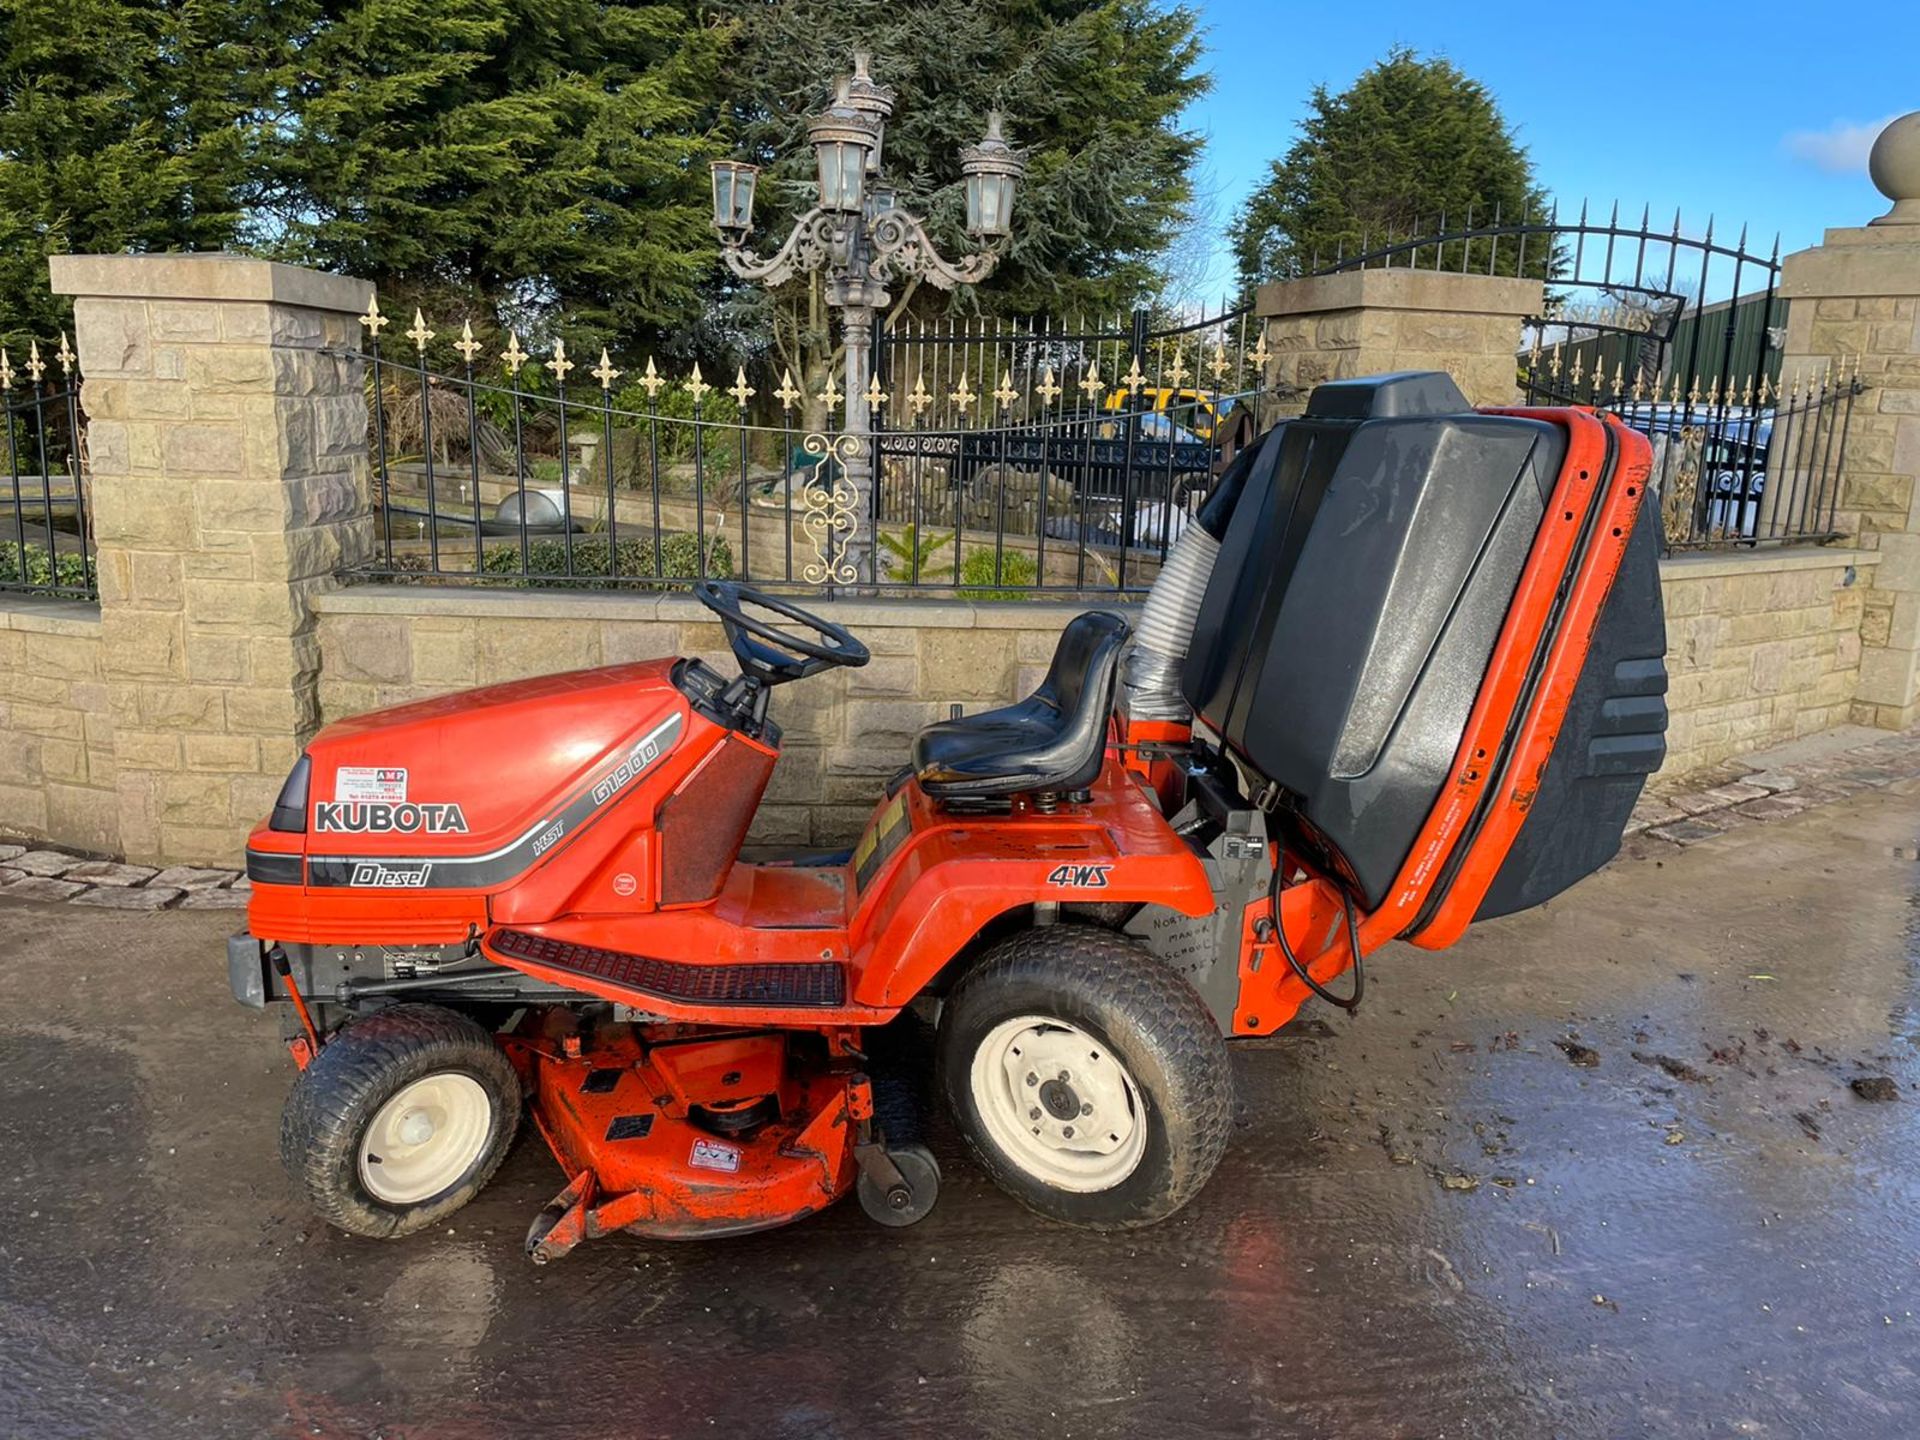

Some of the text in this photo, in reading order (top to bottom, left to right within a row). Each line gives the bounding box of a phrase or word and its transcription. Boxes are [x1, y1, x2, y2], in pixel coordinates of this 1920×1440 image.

[377, 770, 404, 781] AMP
[591, 739, 660, 805] G1900
[315, 802, 469, 833] KUBOTA
[532, 819, 565, 857] HST
[350, 863, 432, 888] Diesel
[1047, 864, 1115, 888] 4WS
